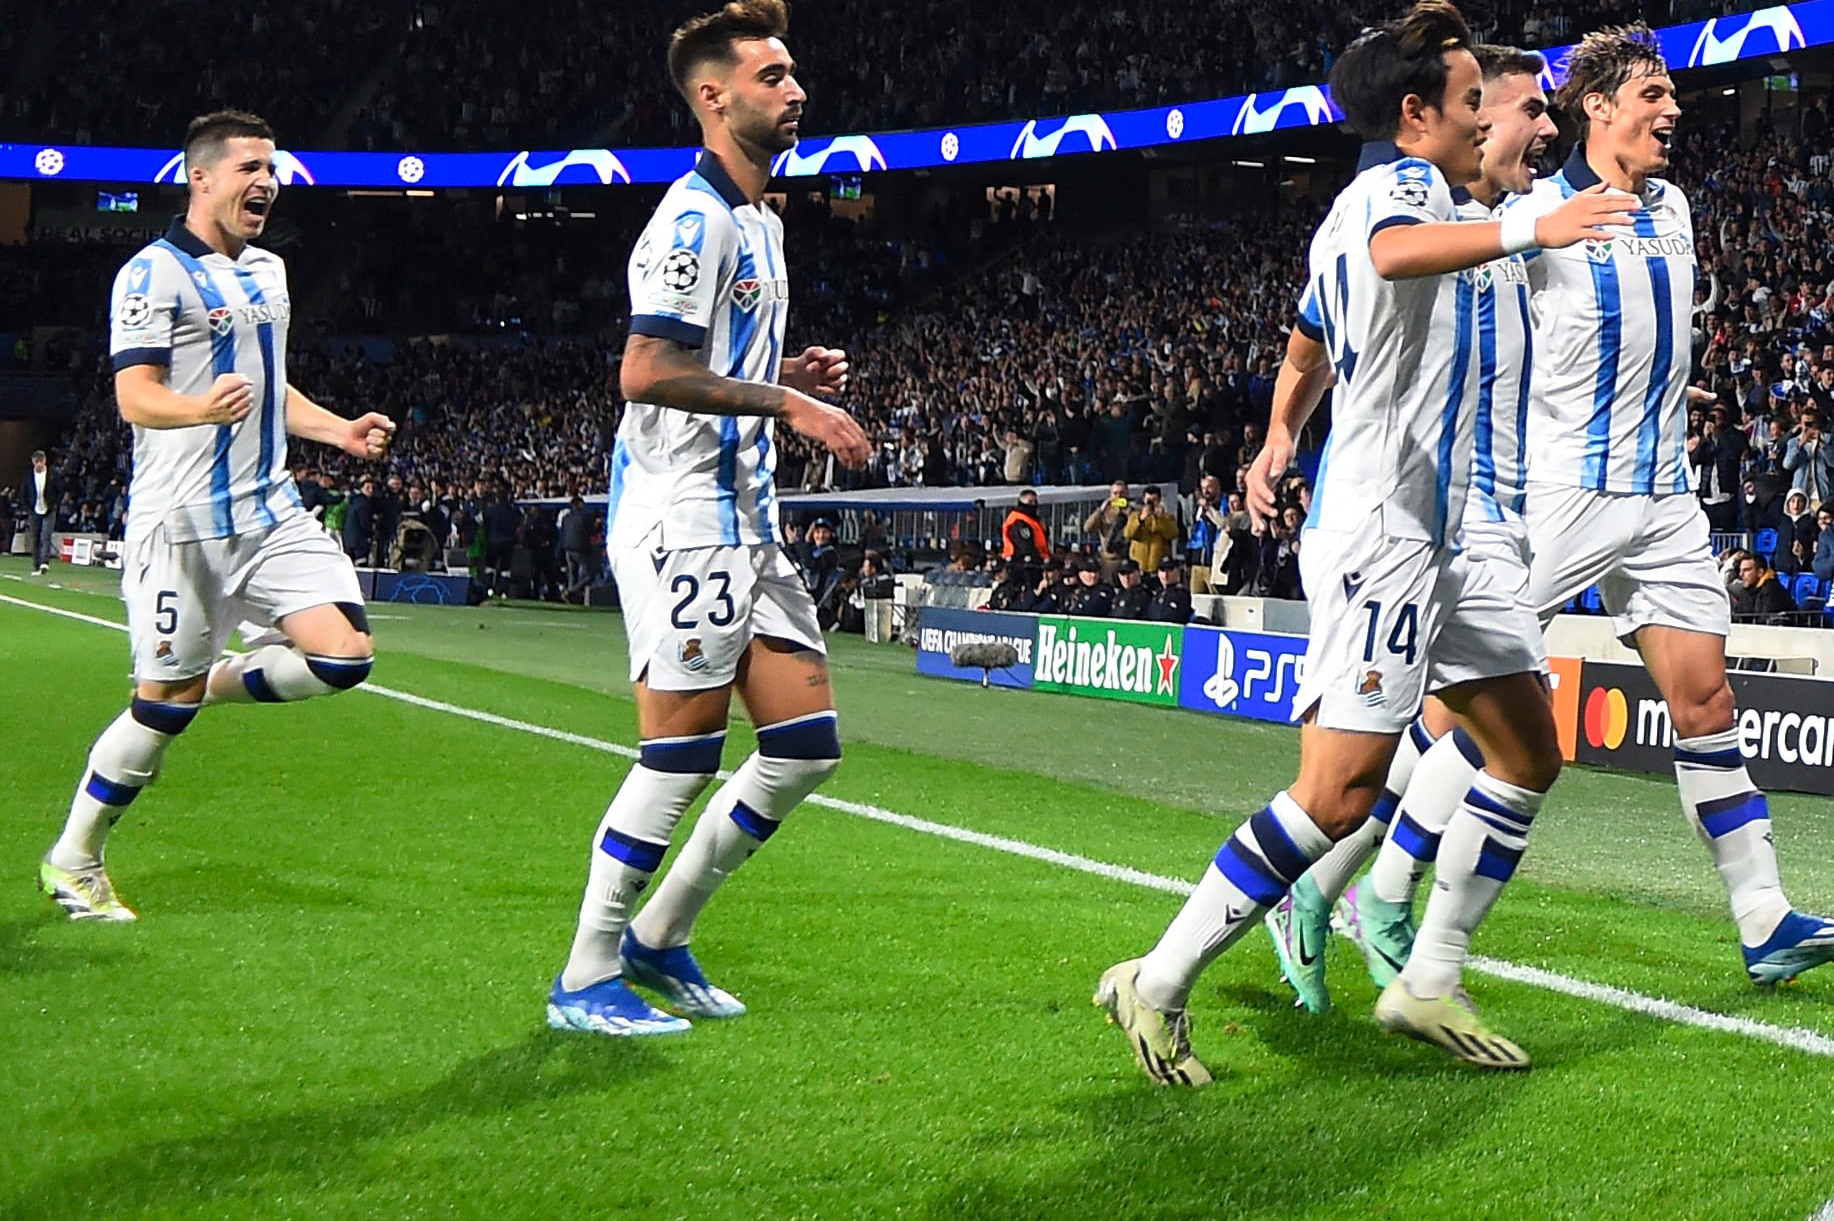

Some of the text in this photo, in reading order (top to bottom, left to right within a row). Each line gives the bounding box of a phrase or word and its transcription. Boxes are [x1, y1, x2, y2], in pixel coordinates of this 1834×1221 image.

[155, 590, 178, 635] 5
[671, 571, 735, 629] 23
[921, 627, 943, 654] UEFA
[1034, 624, 1153, 694] Heineken
[1363, 599, 1418, 665] 14
